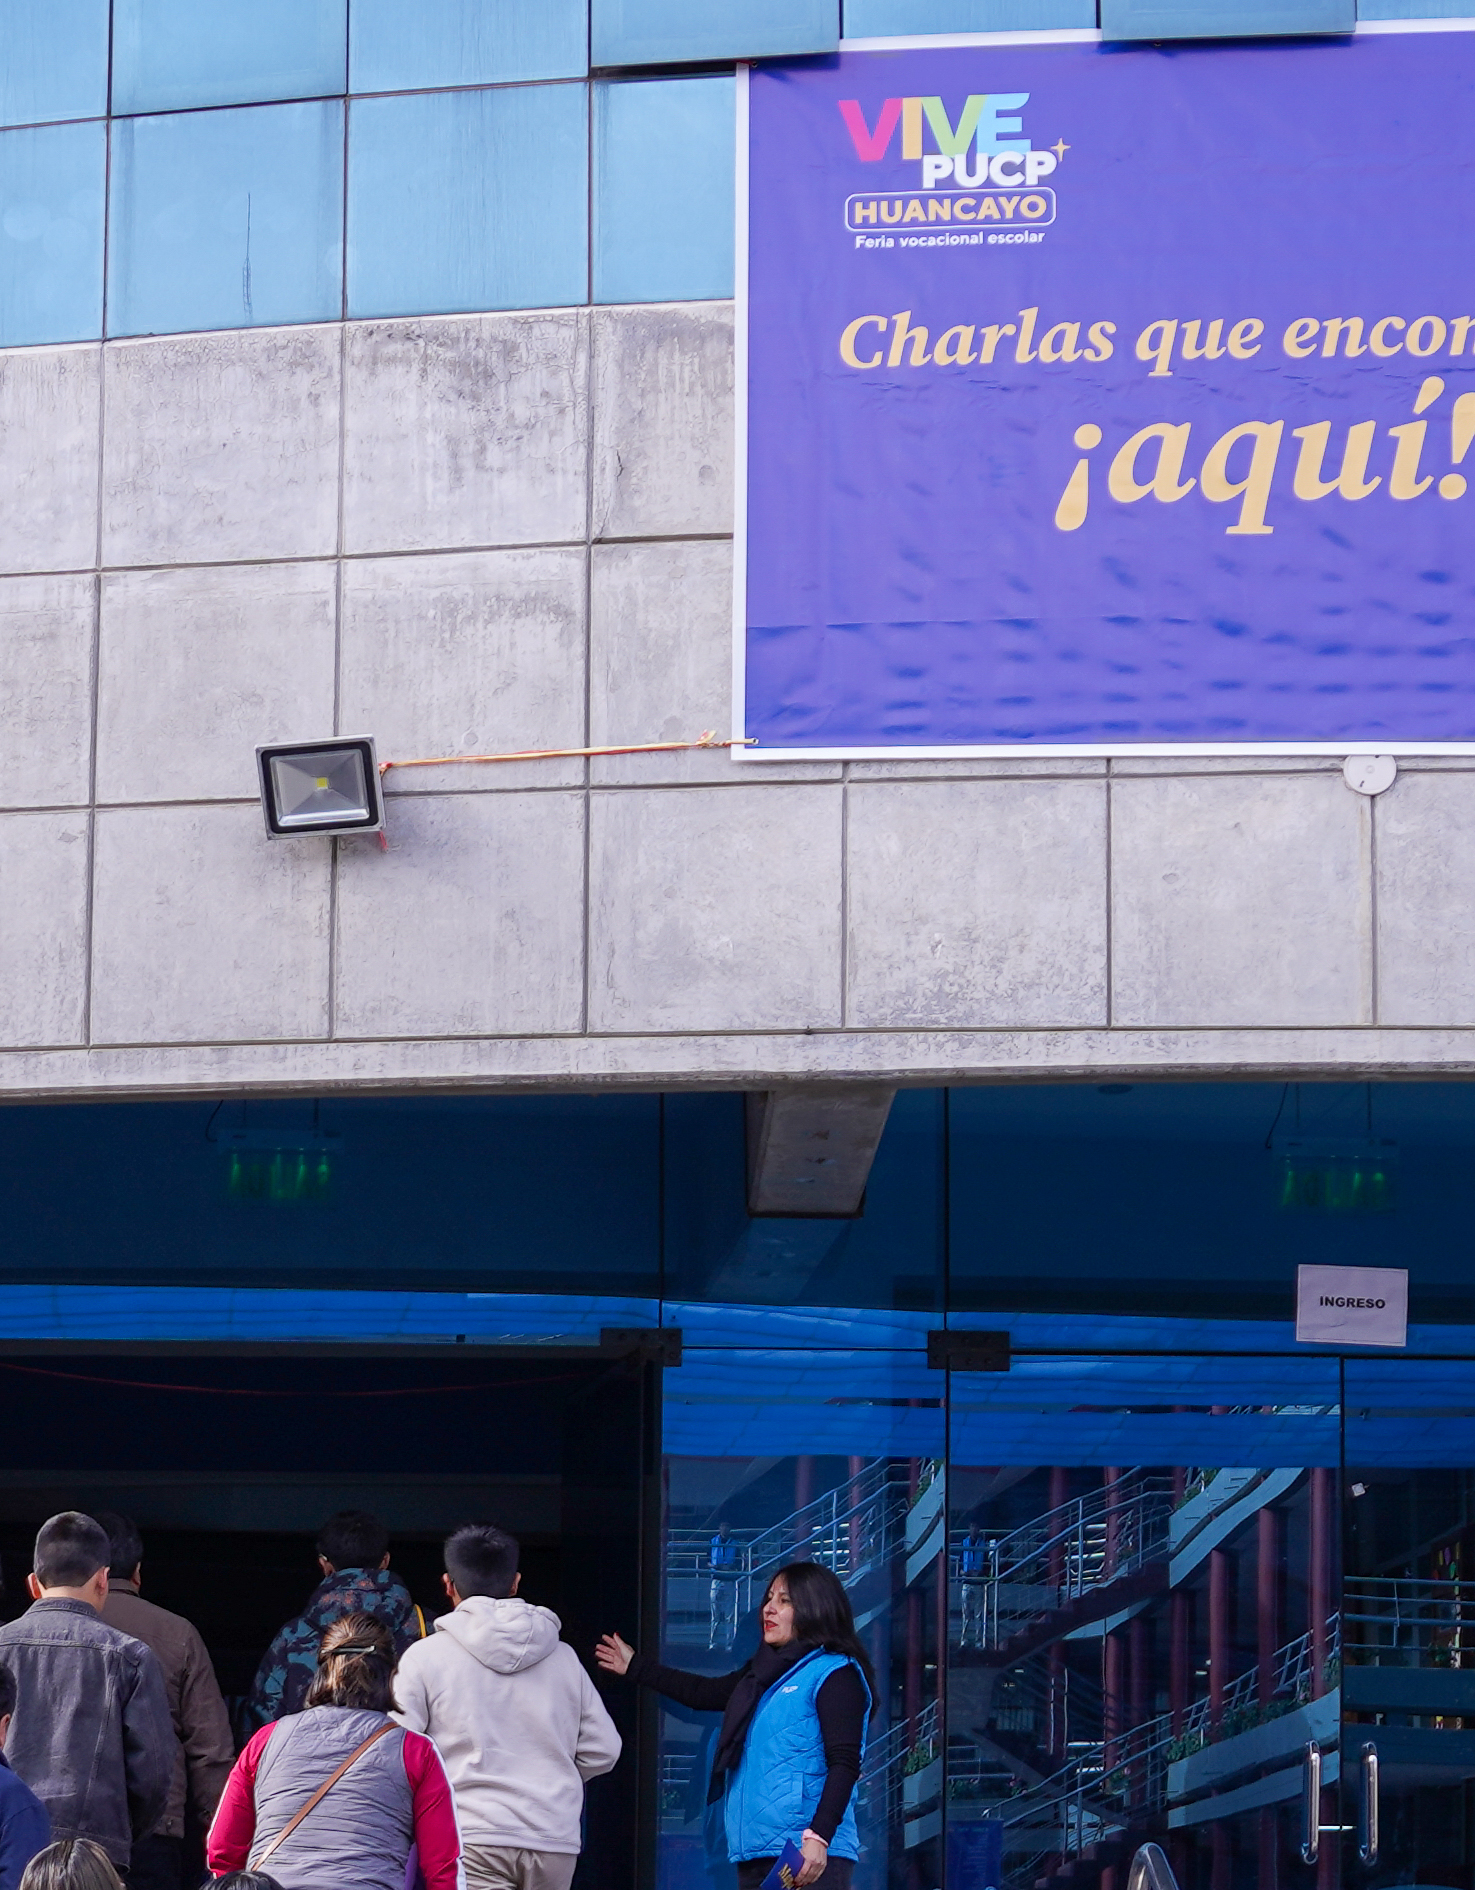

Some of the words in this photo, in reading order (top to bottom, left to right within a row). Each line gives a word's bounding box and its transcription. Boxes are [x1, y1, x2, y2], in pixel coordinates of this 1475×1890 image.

[839, 93, 1031, 162] VIVE
[921, 150, 1058, 191] PUCP
[854, 193, 1048, 227] HUANCAYO
[854, 233, 895, 249] Feria
[899, 230, 984, 248] vocacional
[987, 227, 1046, 245] escolar
[840, 307, 1116, 369] Charlas
[1135, 318, 1264, 376] que
[1320, 1296, 1385, 1309] INGRESO
